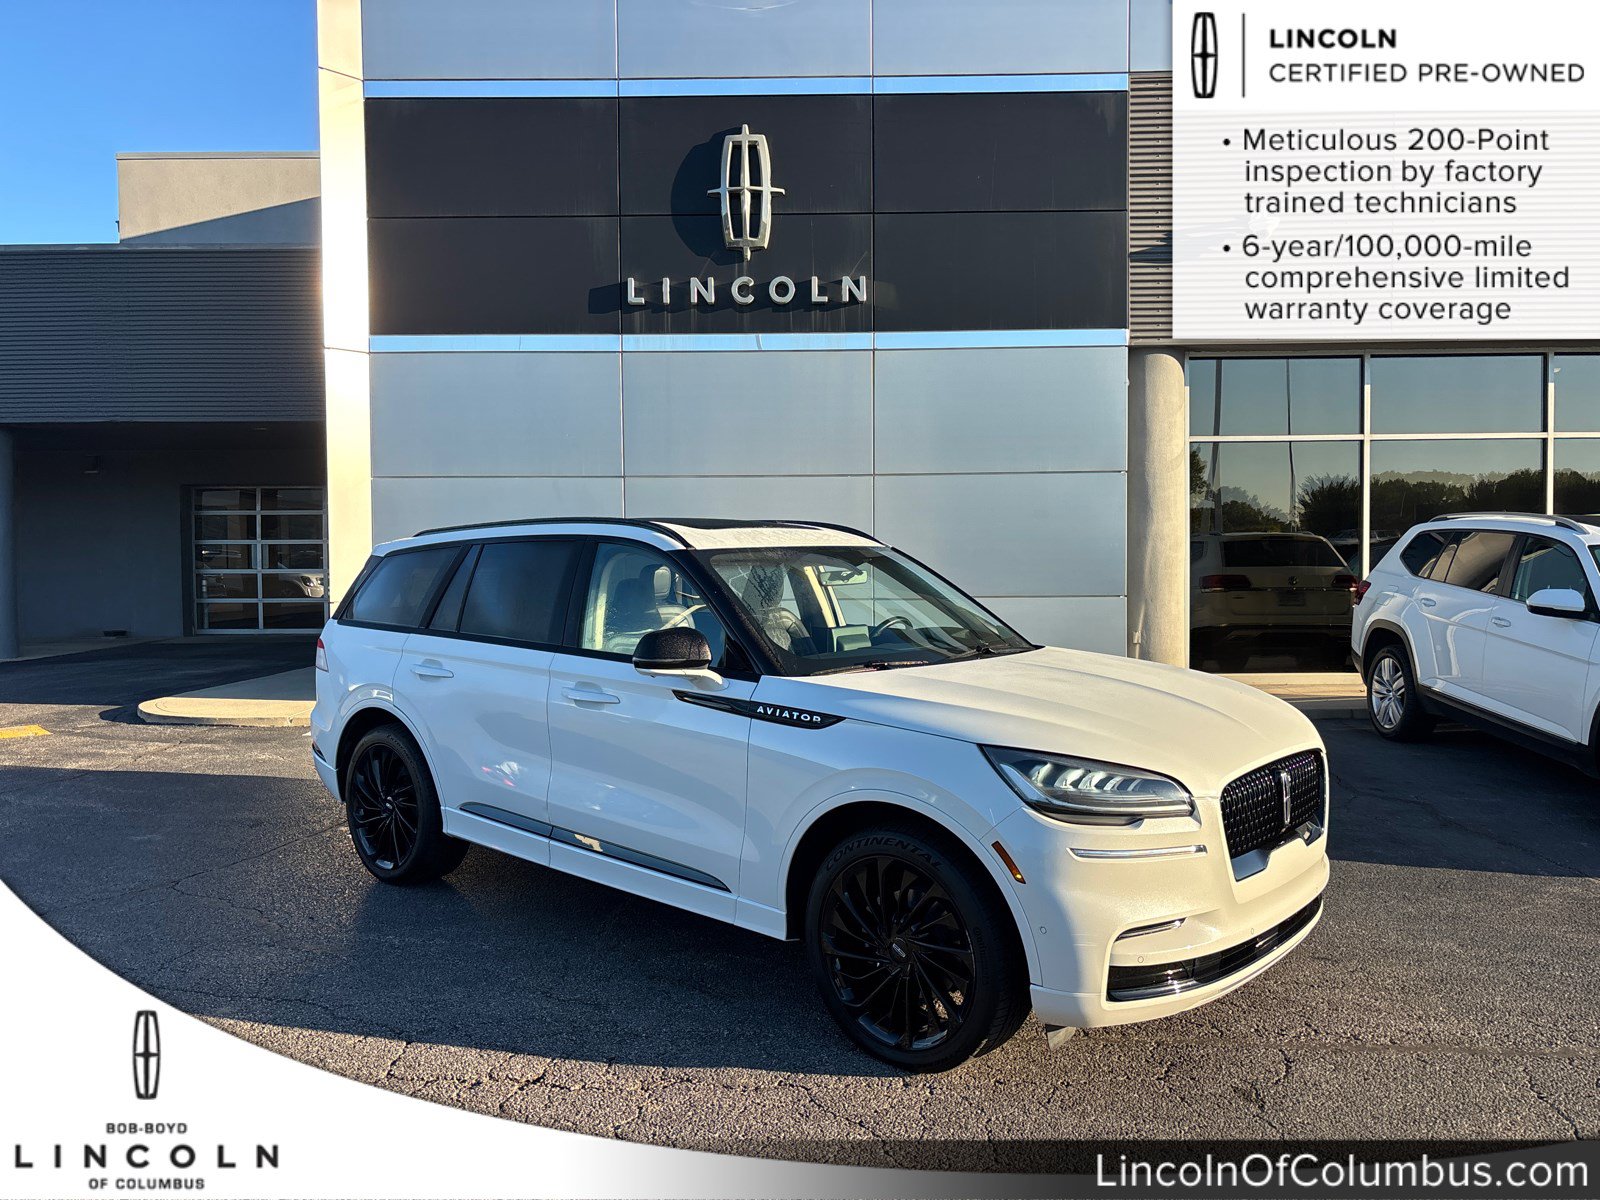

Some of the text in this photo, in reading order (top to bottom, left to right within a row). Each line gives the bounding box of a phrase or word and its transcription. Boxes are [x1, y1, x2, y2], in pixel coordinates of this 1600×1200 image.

[627, 275, 867, 305] LINCOLN
[756, 705, 822, 724] AVIATOR
[826, 836, 944, 873] CONTINENTAL
